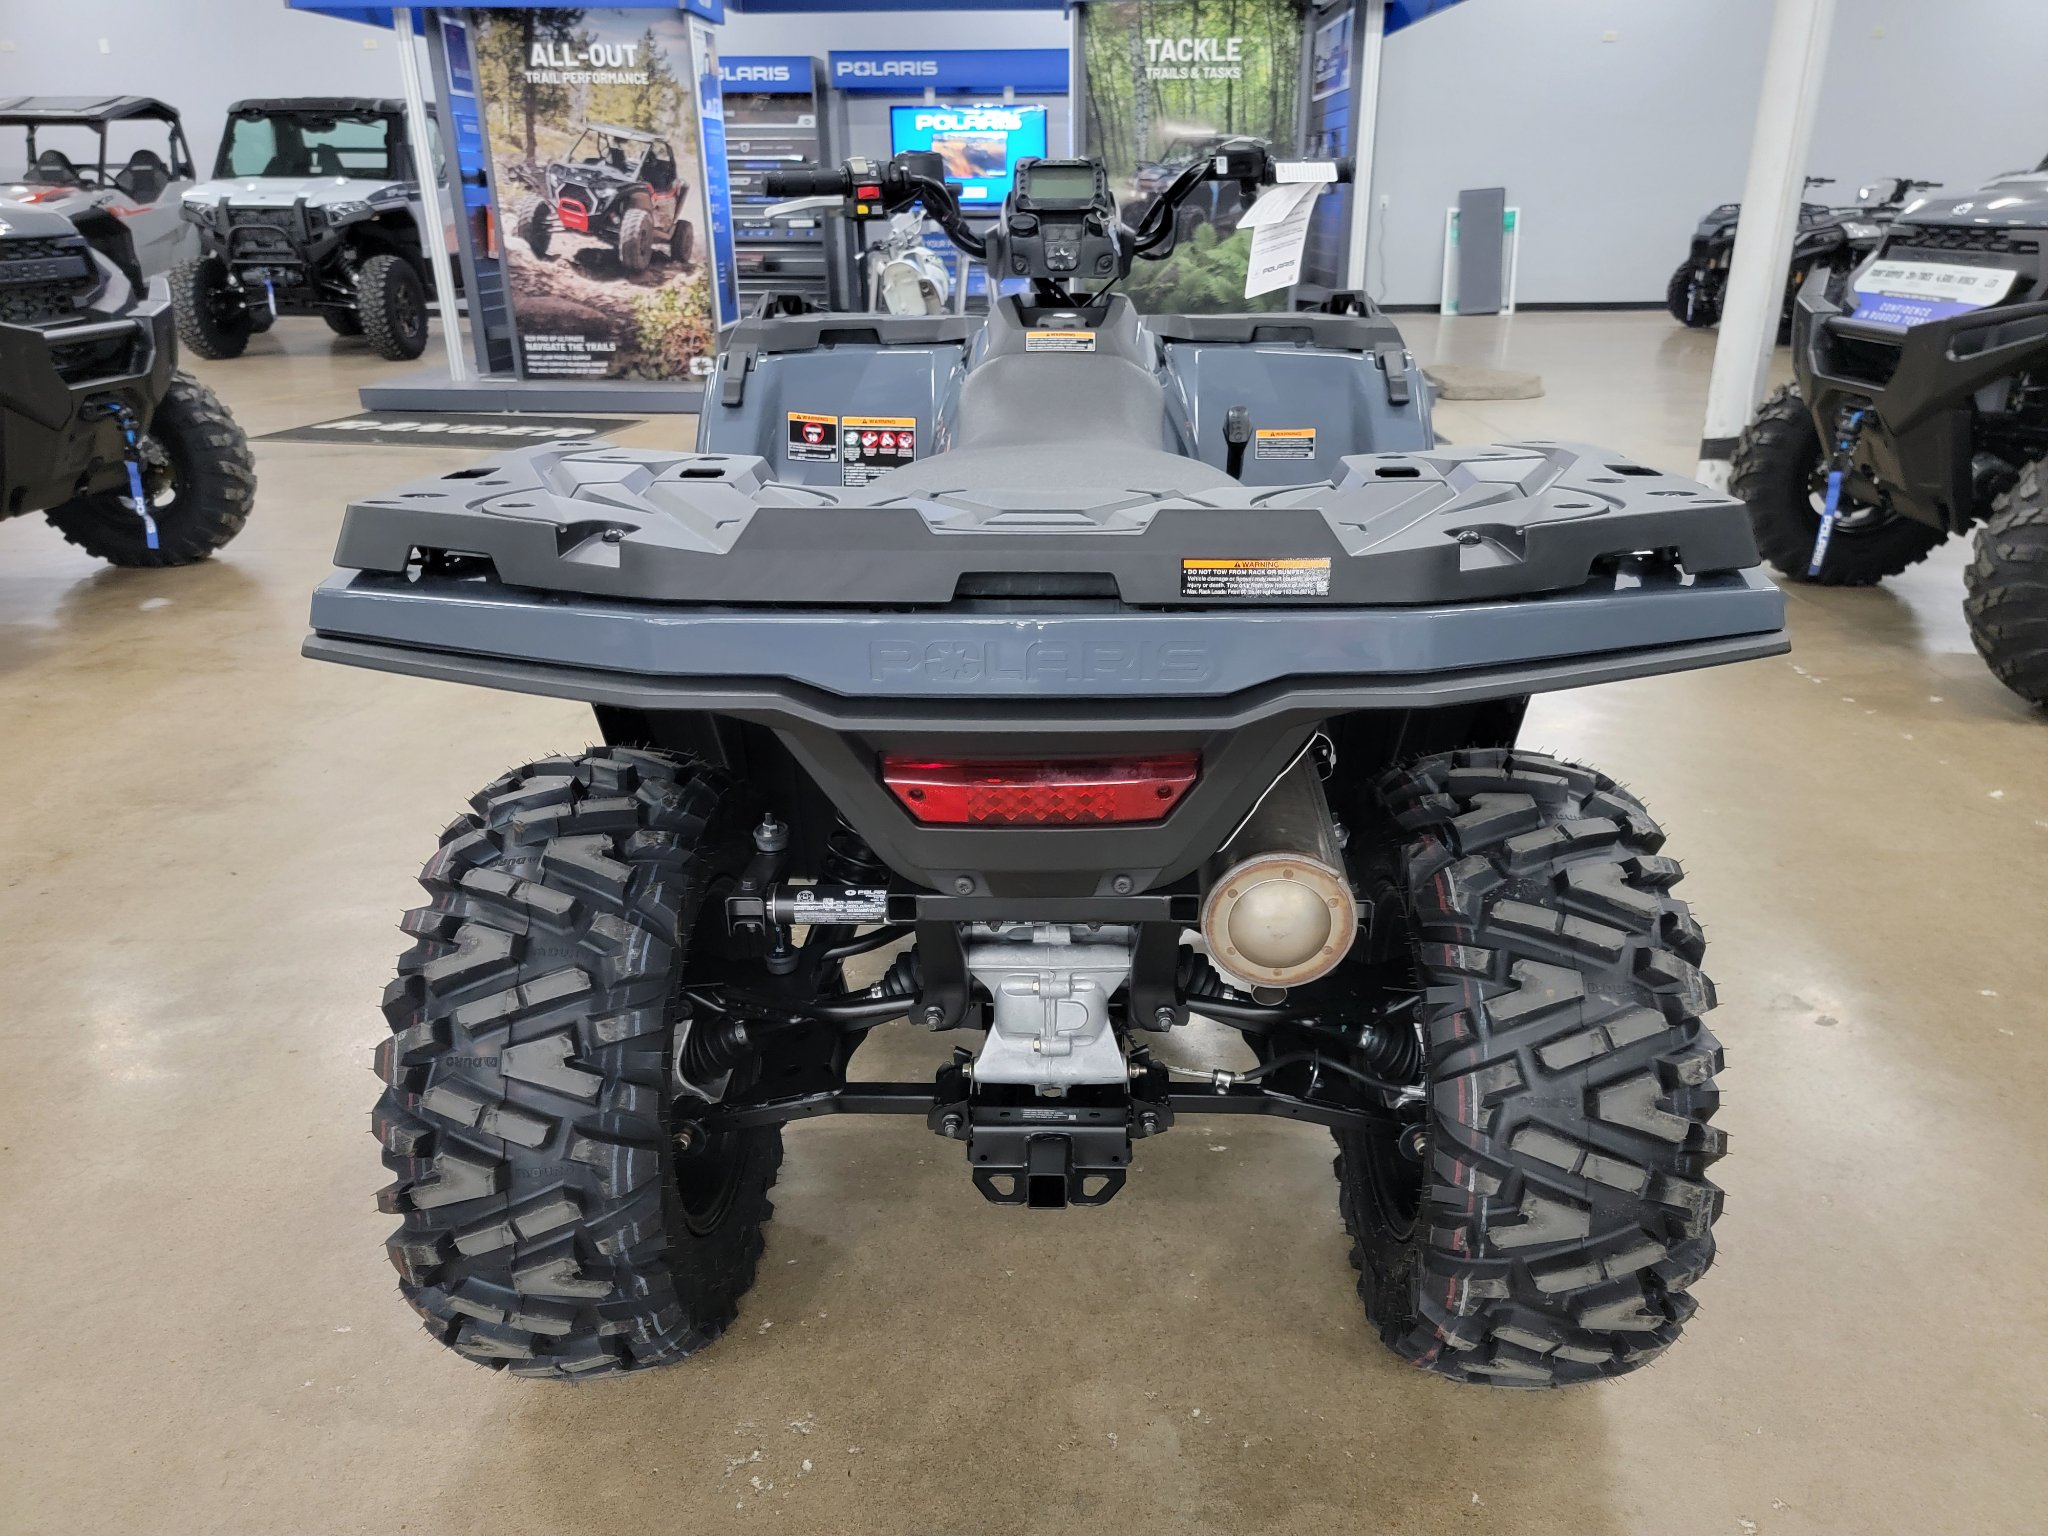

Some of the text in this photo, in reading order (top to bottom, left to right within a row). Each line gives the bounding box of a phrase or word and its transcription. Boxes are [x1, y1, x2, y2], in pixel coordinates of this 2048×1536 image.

[530, 42, 639, 68] ALL-OUT
[1145, 38, 1243, 62] TACKLE
[718, 66, 790, 82] LARIS
[837, 60, 939, 77] POLARIS
[1145, 67, 1242, 80] TRAILS & TASKS
[525, 71, 650, 86] TRAIL PERFORMANCE
[915, 112, 1023, 131] POLARIS
[1262, 259, 1296, 275] POLARIS
[525, 342, 617, 352] NAVIGATE THE TRAILS
[309, 419, 598, 438] RANGER
[1811, 515, 1834, 567] POLARIS
[867, 639, 1213, 682] POLARIS
